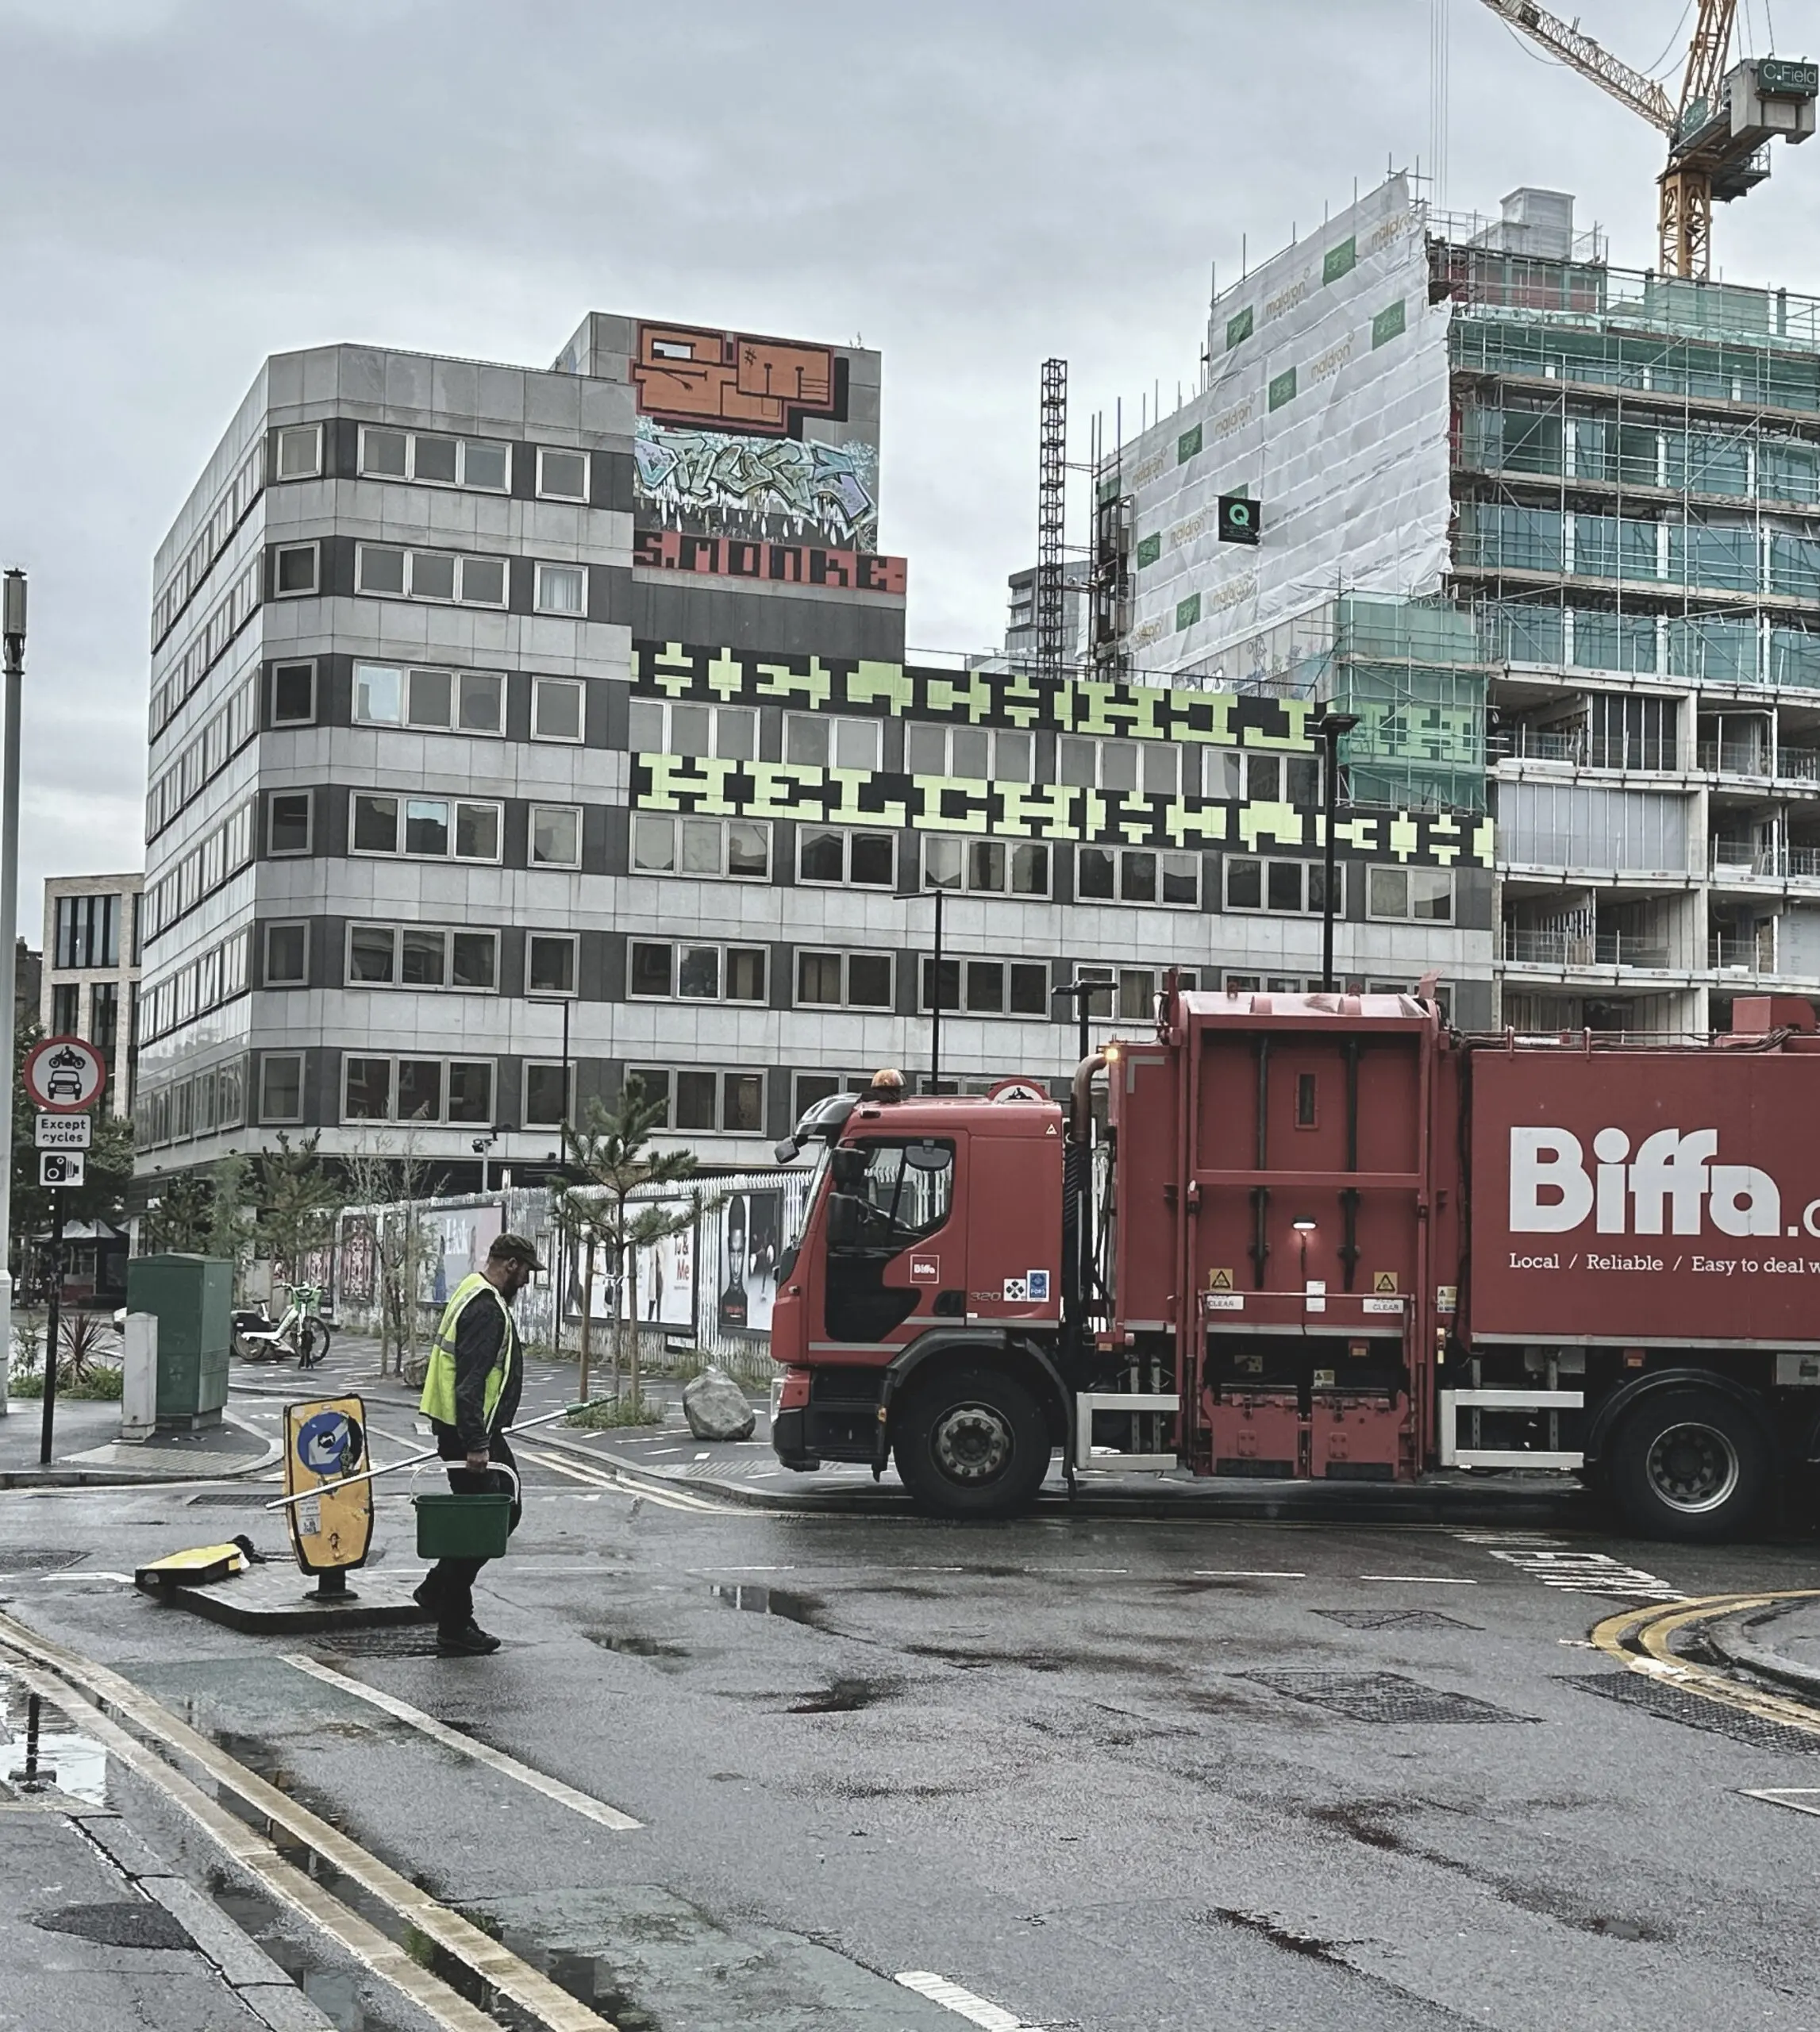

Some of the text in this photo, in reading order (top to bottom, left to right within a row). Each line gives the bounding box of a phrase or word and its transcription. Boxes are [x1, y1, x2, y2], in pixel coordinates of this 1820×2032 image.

[1310, 343, 1350, 379] maldron
[1229, 504, 1249, 525] Q
[41, 1118, 86, 1130] Except
[42, 1132, 83, 1143] cycles
[1509, 1253, 1560, 1269] Local
[1587, 1253, 1664, 1272] Reliable
[1691, 1256, 1737, 1276] Easy
[1741, 1258, 1758, 1273] to
[1763, 1257, 1805, 1273] deal
[970, 1291, 1001, 1301] 320
